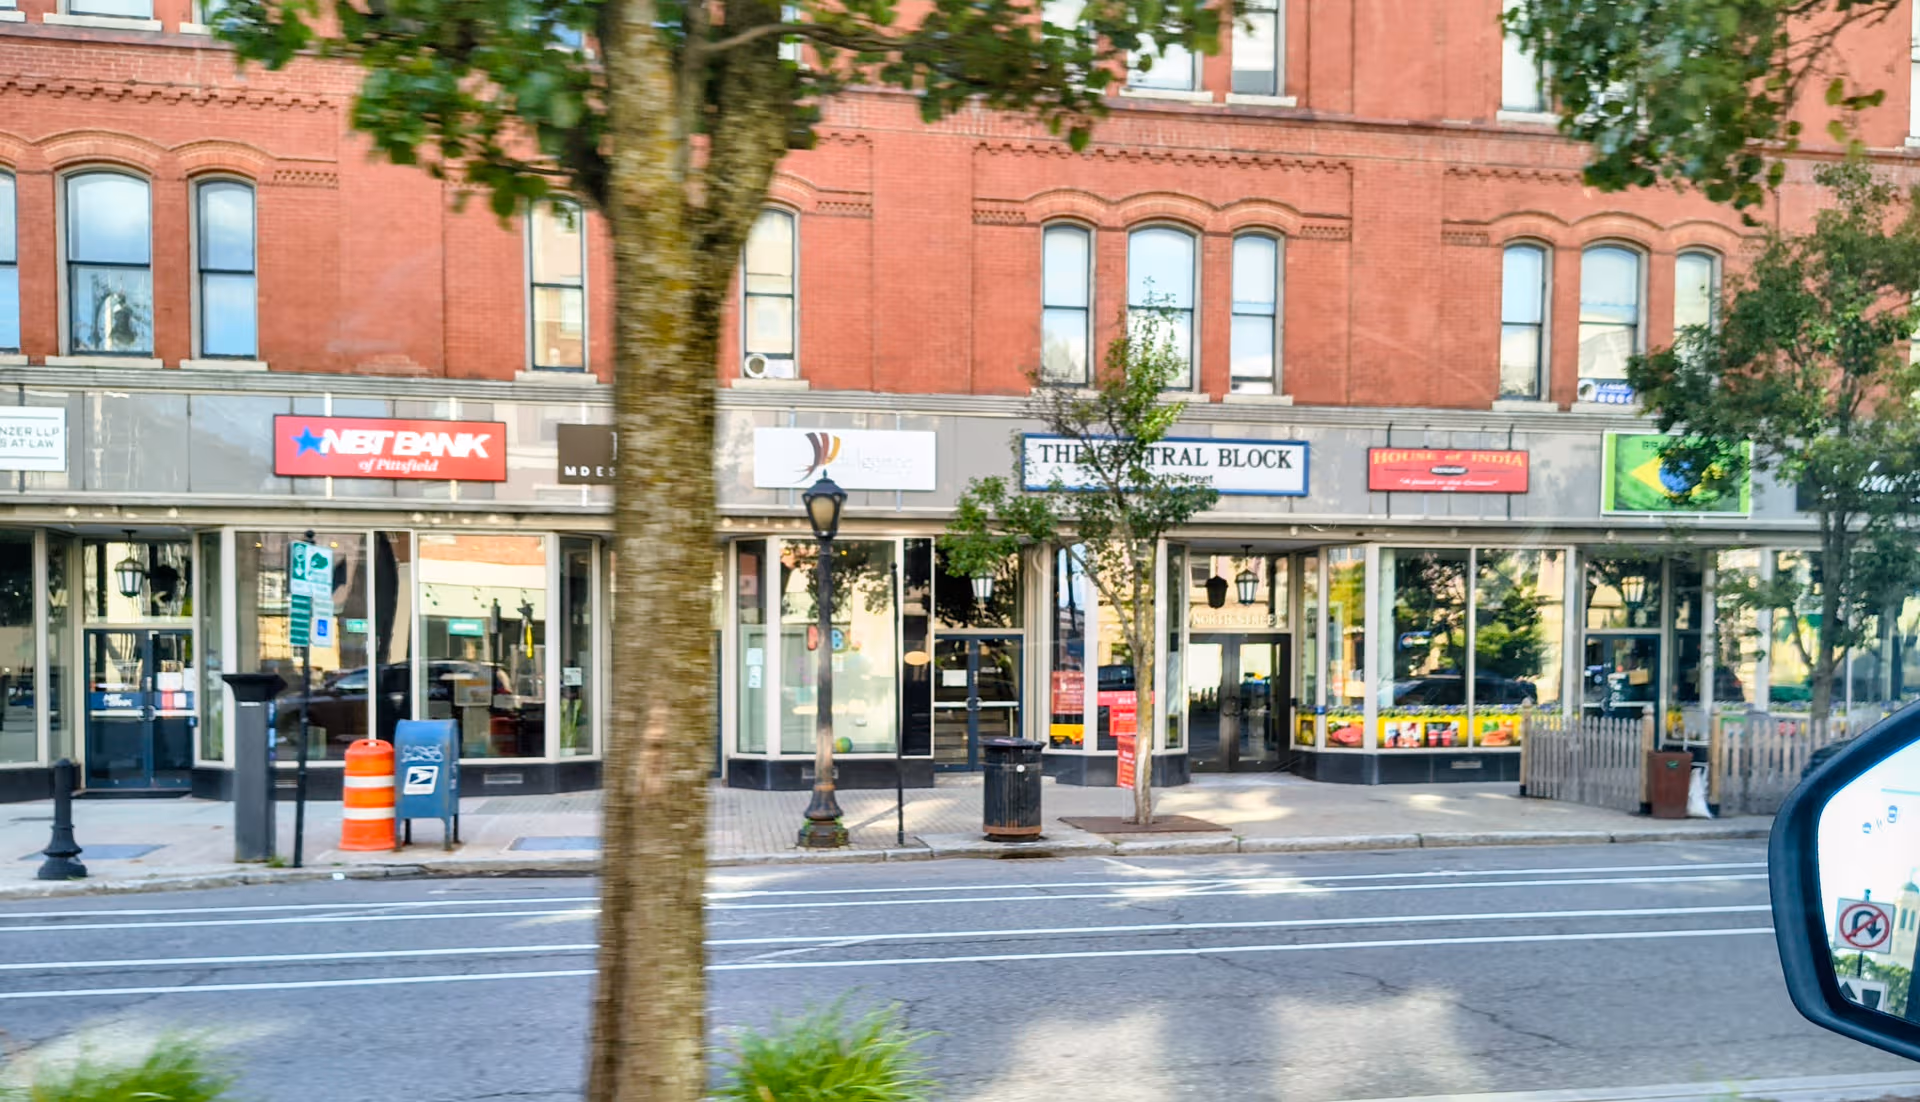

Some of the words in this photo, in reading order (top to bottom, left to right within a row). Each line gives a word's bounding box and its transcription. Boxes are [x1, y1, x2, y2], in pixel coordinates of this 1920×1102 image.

[36, 427, 60, 437] LLP
[11, 438, 26, 448] AT
[29, 439, 55, 449] LAW
[319, 428, 394, 456] NBT
[392, 430, 491, 458] BANK
[1096, 443, 1209, 467] CTRAL
[1217, 448, 1293, 469] BLOCK
[1373, 451, 1437, 465] HOUSE
[1472, 451, 1524, 467] INDIA
[358, 458, 377, 474] of
[376, 458, 440, 475] Pittsfield
